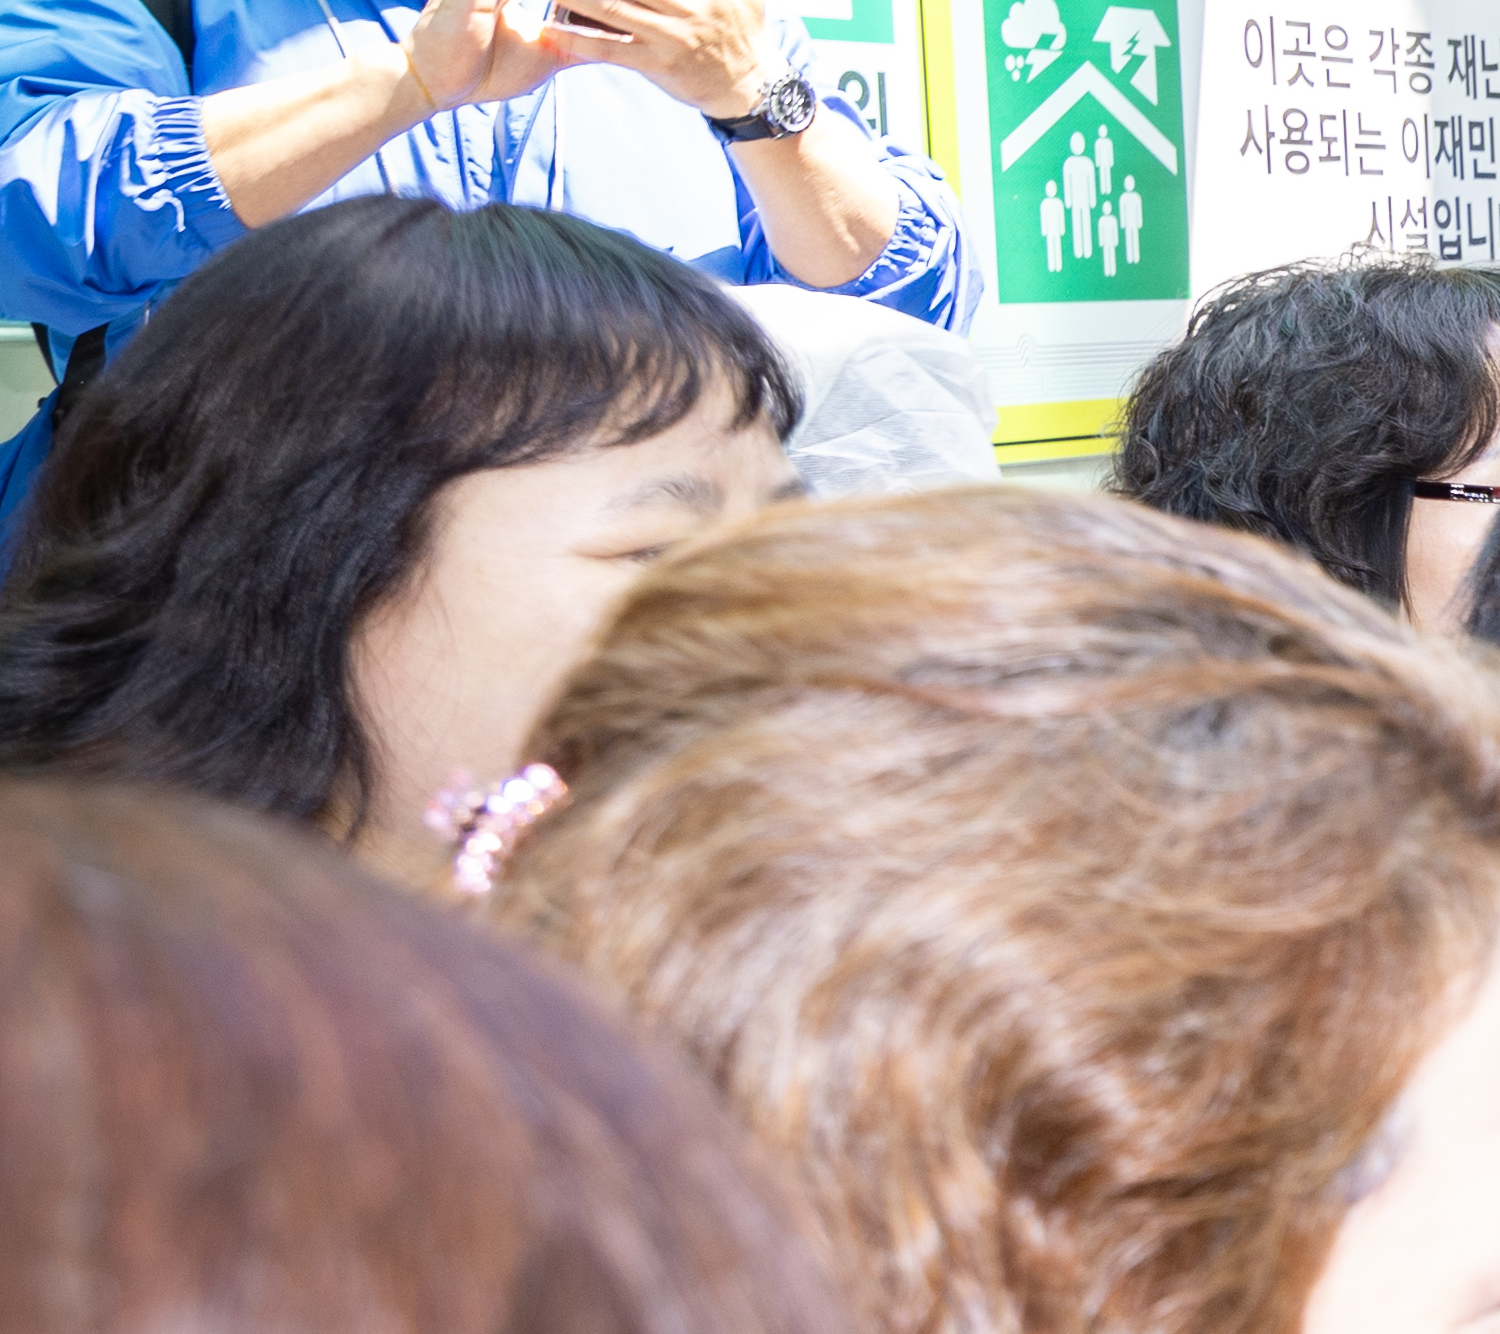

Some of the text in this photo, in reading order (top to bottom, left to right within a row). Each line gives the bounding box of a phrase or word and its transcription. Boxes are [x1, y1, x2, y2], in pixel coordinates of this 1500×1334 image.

[1243, 15, 1354, 89] 이곳은
[1368, 27, 1435, 95] 각종
[1240, 104, 1387, 177] 사용되는
[1401, 113, 1497, 180] 이재민
